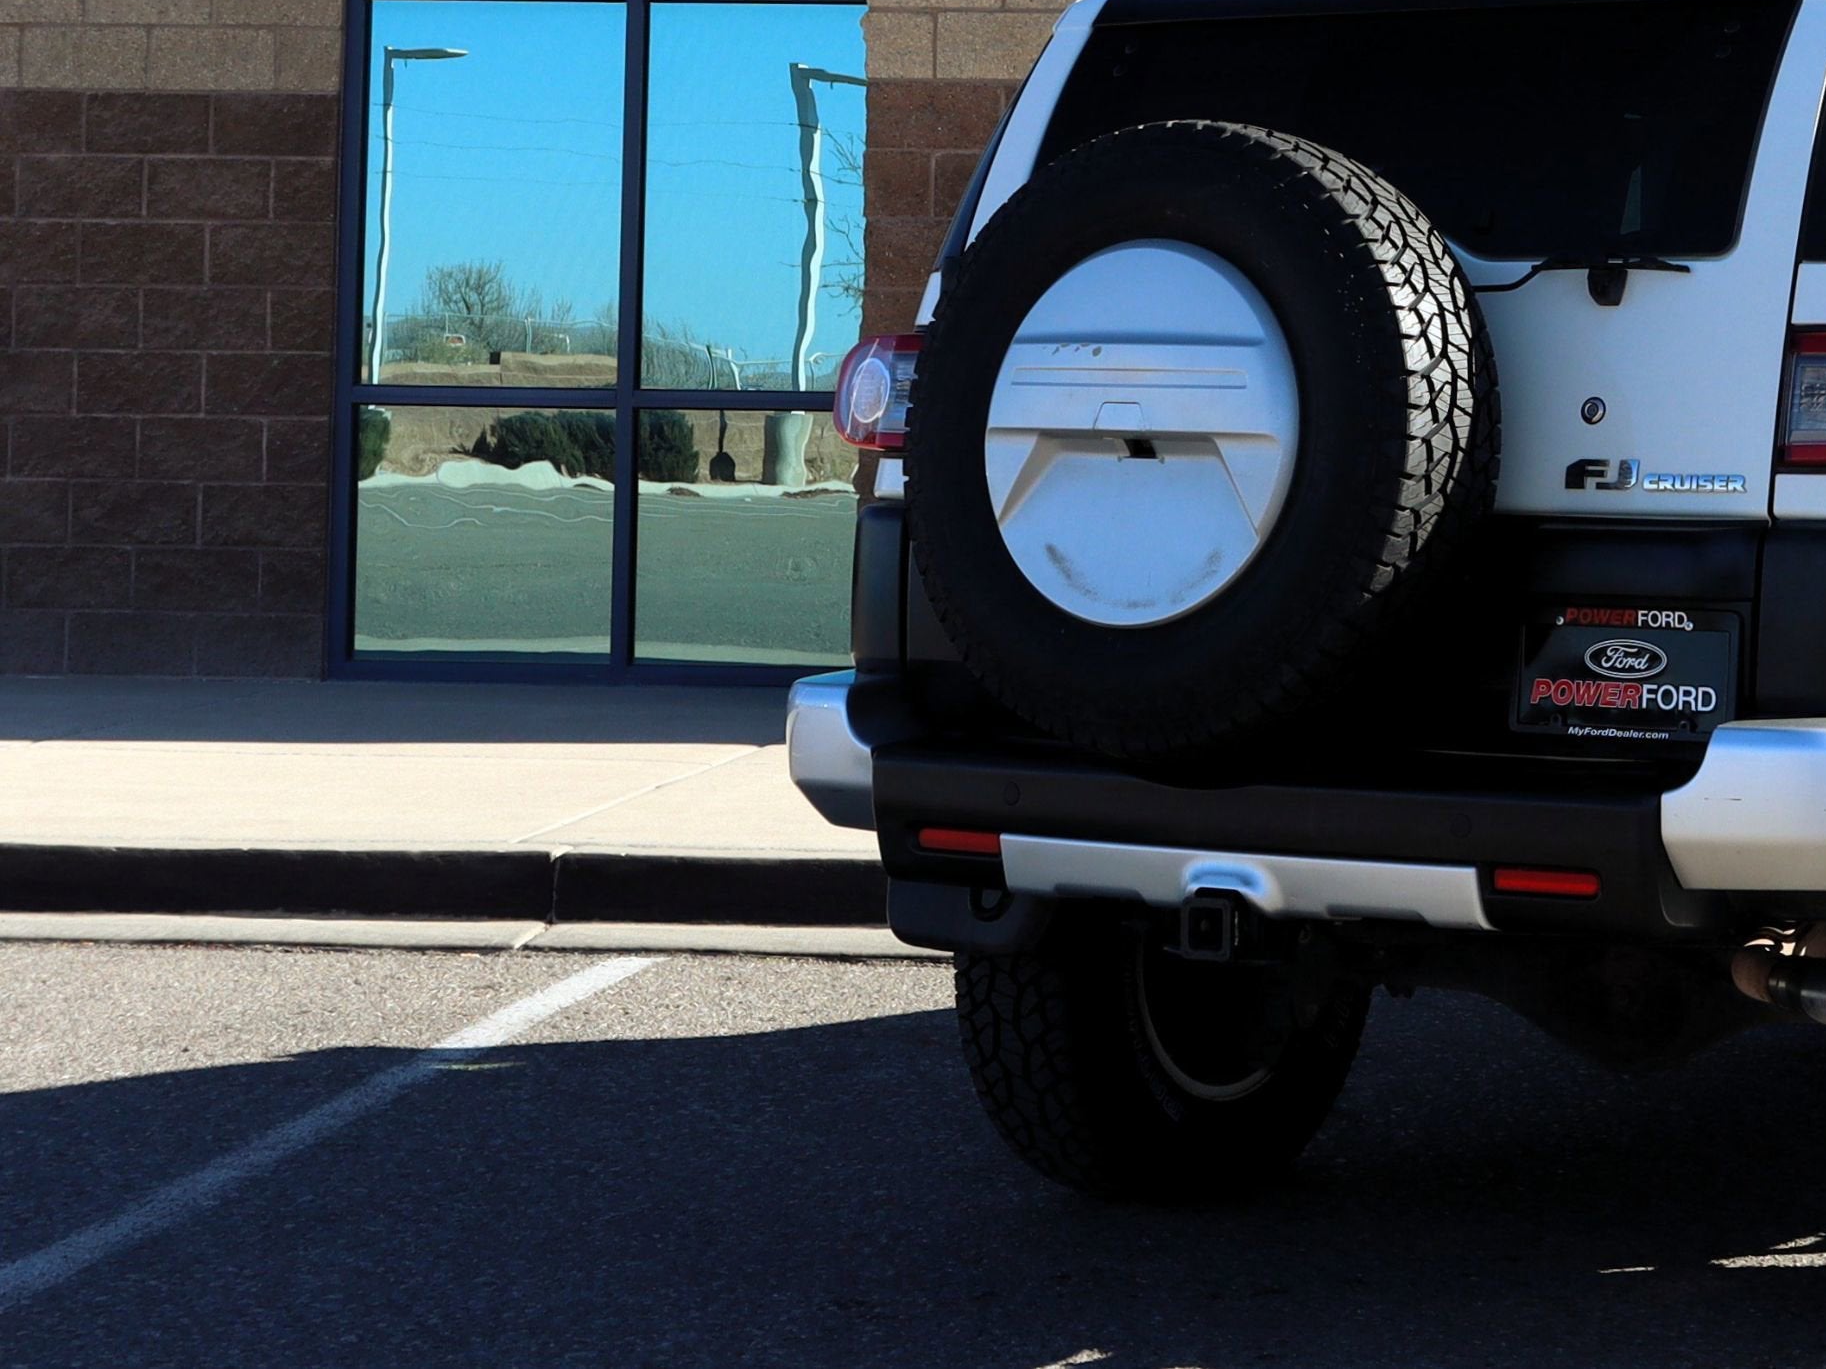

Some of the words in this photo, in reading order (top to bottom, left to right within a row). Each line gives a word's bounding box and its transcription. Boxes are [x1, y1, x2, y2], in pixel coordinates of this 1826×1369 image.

[1564, 458, 1640, 490] FJ
[1643, 473, 1747, 493] CRUISER
[1600, 645, 1650, 671] Ford
[1567, 725, 1670, 741] MyFordDealer.com
